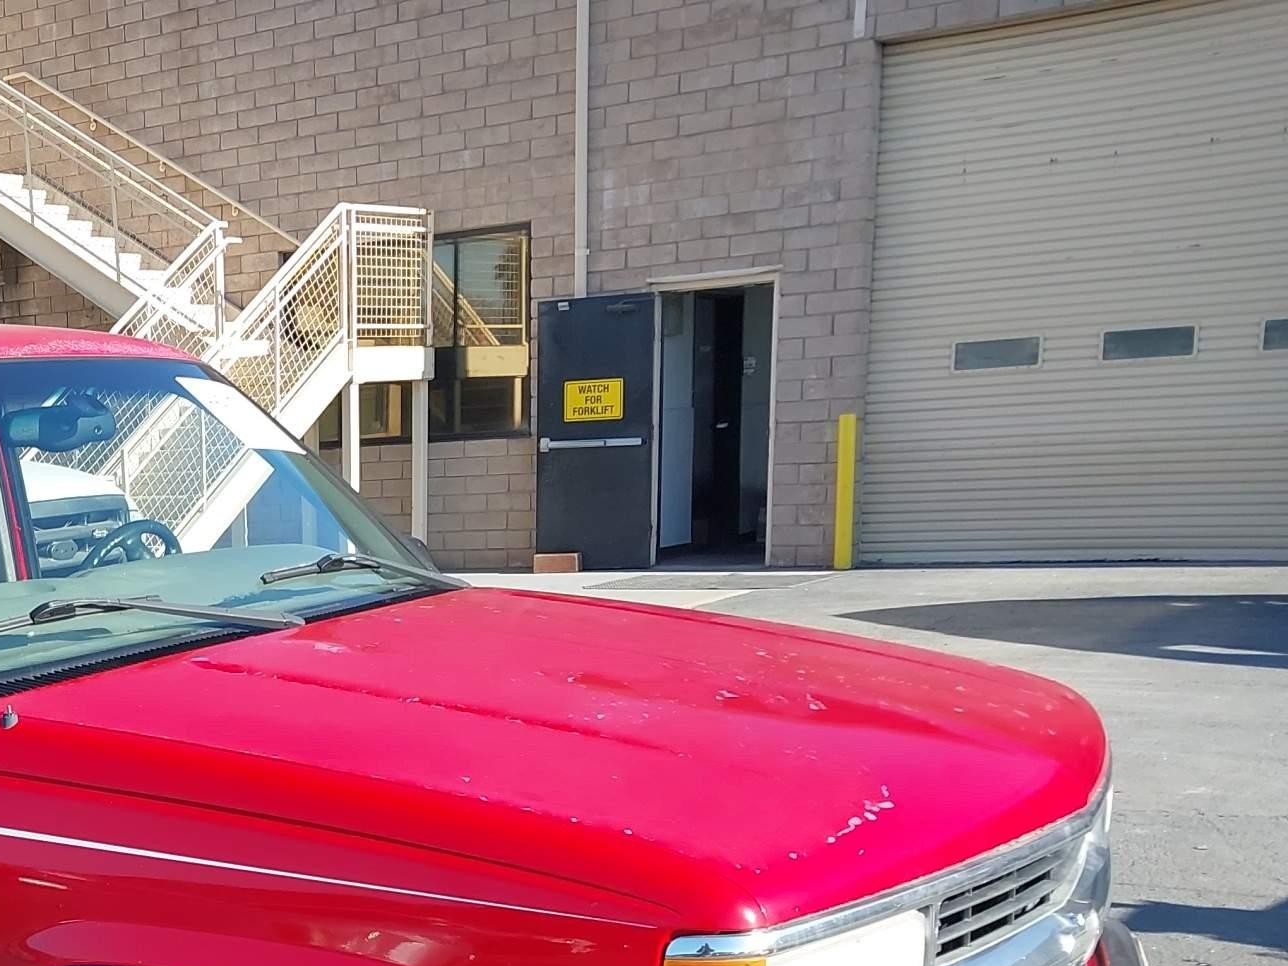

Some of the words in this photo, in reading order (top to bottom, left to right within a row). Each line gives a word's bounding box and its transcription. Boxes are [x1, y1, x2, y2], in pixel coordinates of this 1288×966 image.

[578, 383, 609, 395] WATCH
[584, 395, 603, 405] FOR
[572, 405, 615, 417] FORKLIFT
